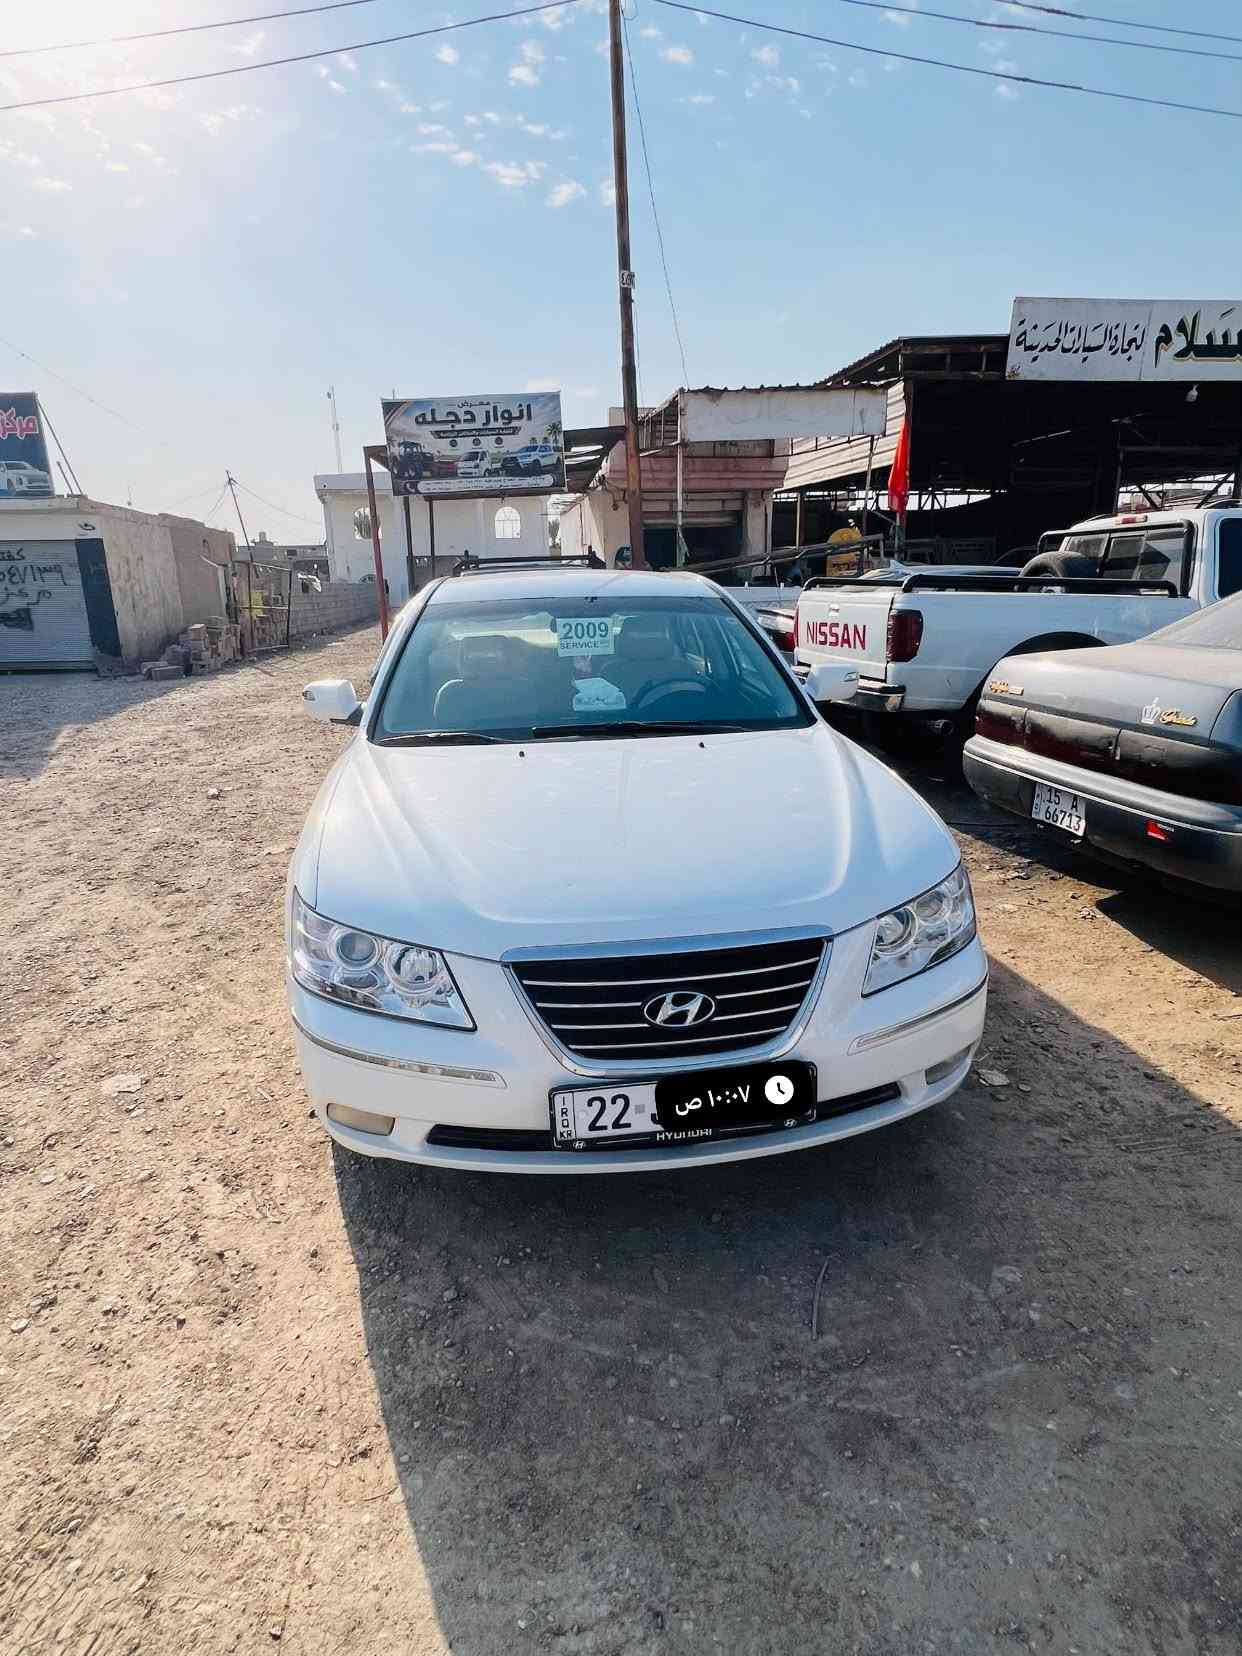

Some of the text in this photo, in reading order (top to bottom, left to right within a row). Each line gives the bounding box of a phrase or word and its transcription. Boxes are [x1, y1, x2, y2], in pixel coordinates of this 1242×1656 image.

[1063, 322, 1112, 364] السيارات
[414, 403, 532, 430] انوار دجله
[560, 622, 609, 640] 2009
[806, 621, 867, 650] NISSAN
[560, 640, 601, 650] SERVICE
[1046, 788, 1061, 805] 15
[1045, 805, 1082, 832] 66713
[586, 1094, 632, 1132] 22
